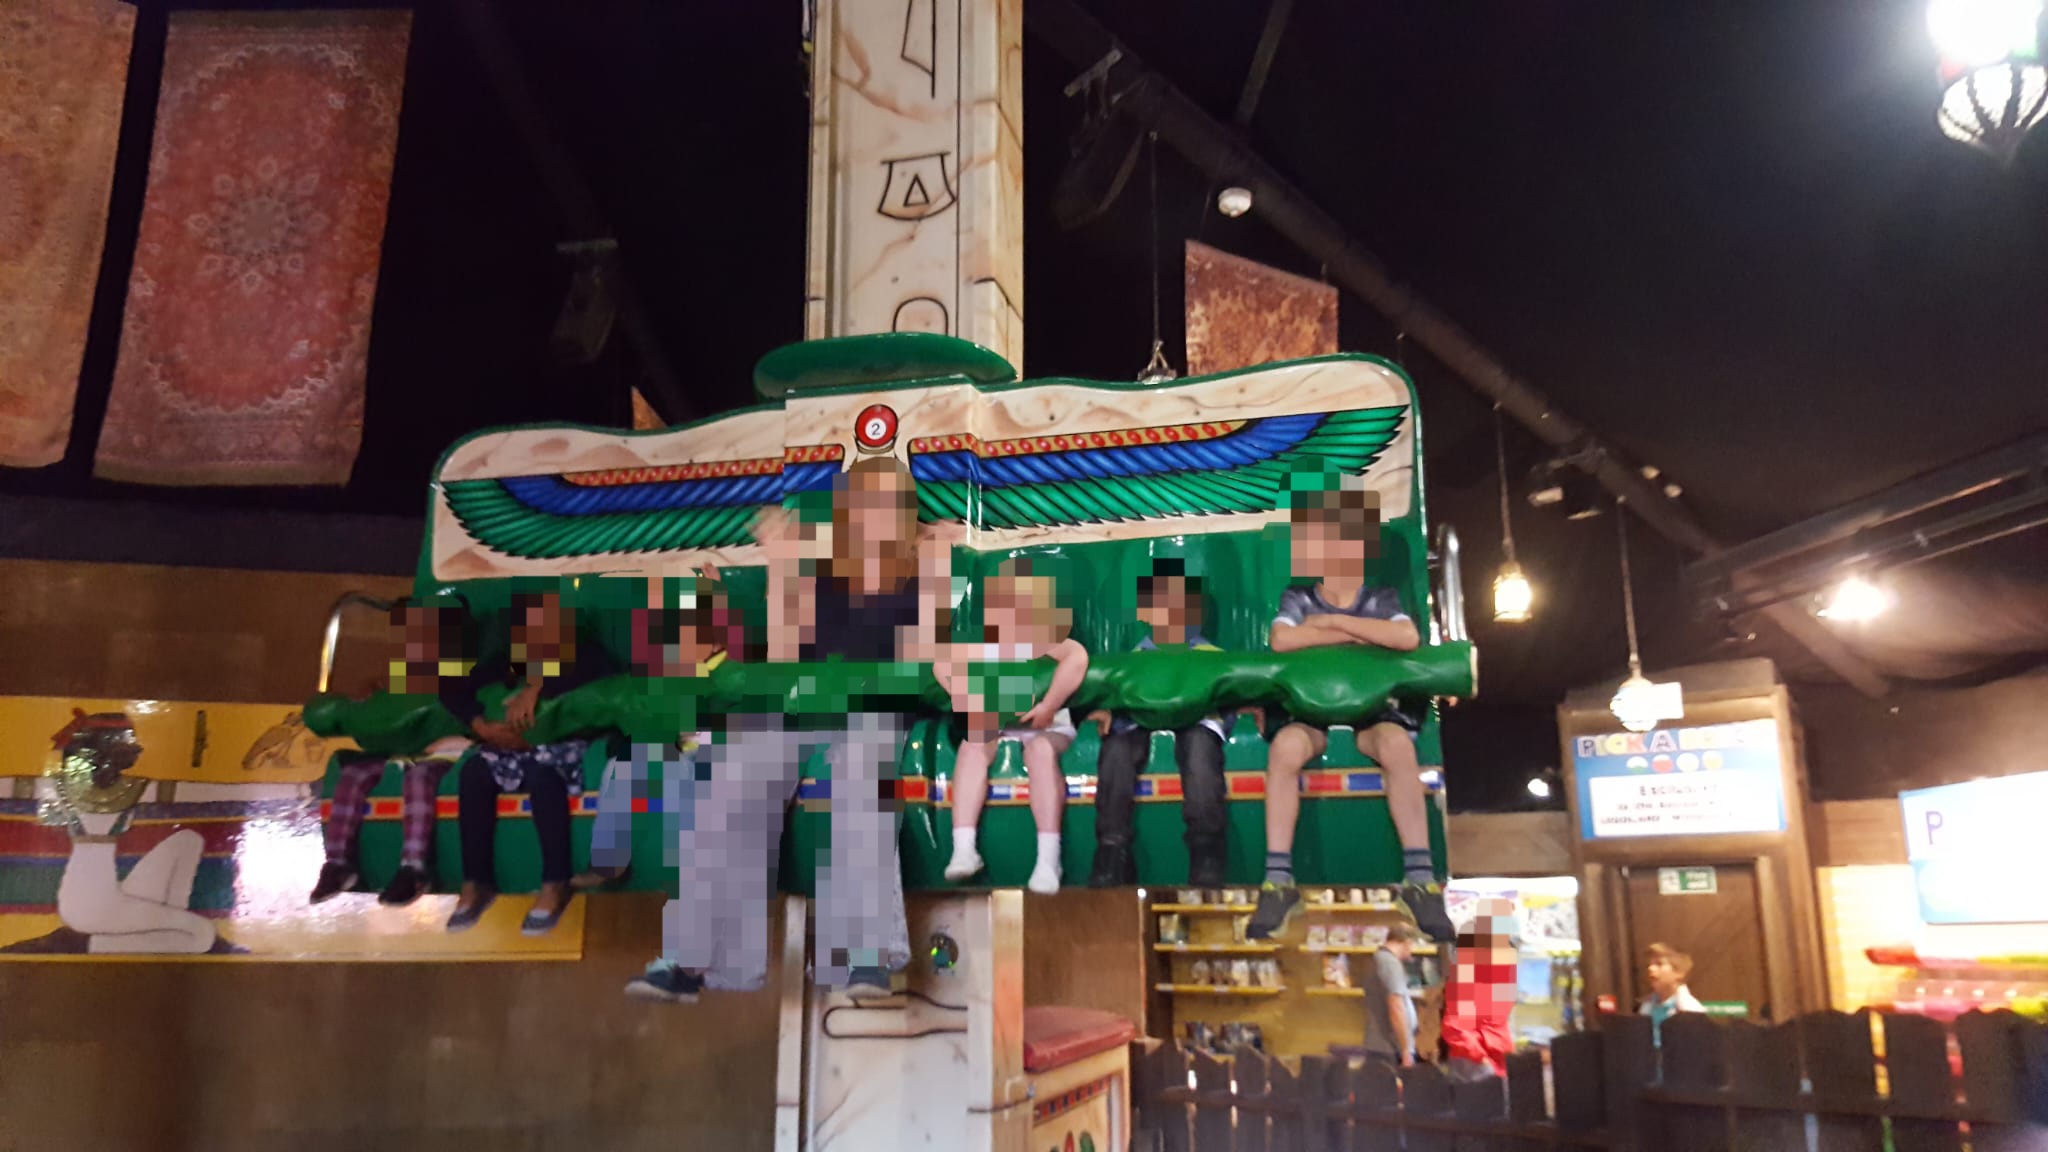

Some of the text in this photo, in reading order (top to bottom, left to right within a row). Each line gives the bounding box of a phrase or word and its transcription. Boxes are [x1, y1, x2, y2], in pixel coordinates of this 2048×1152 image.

[871, 423, 881, 436] 2
[1577, 733, 1648, 757] PICK
[1651, 729, 1678, 752] A
